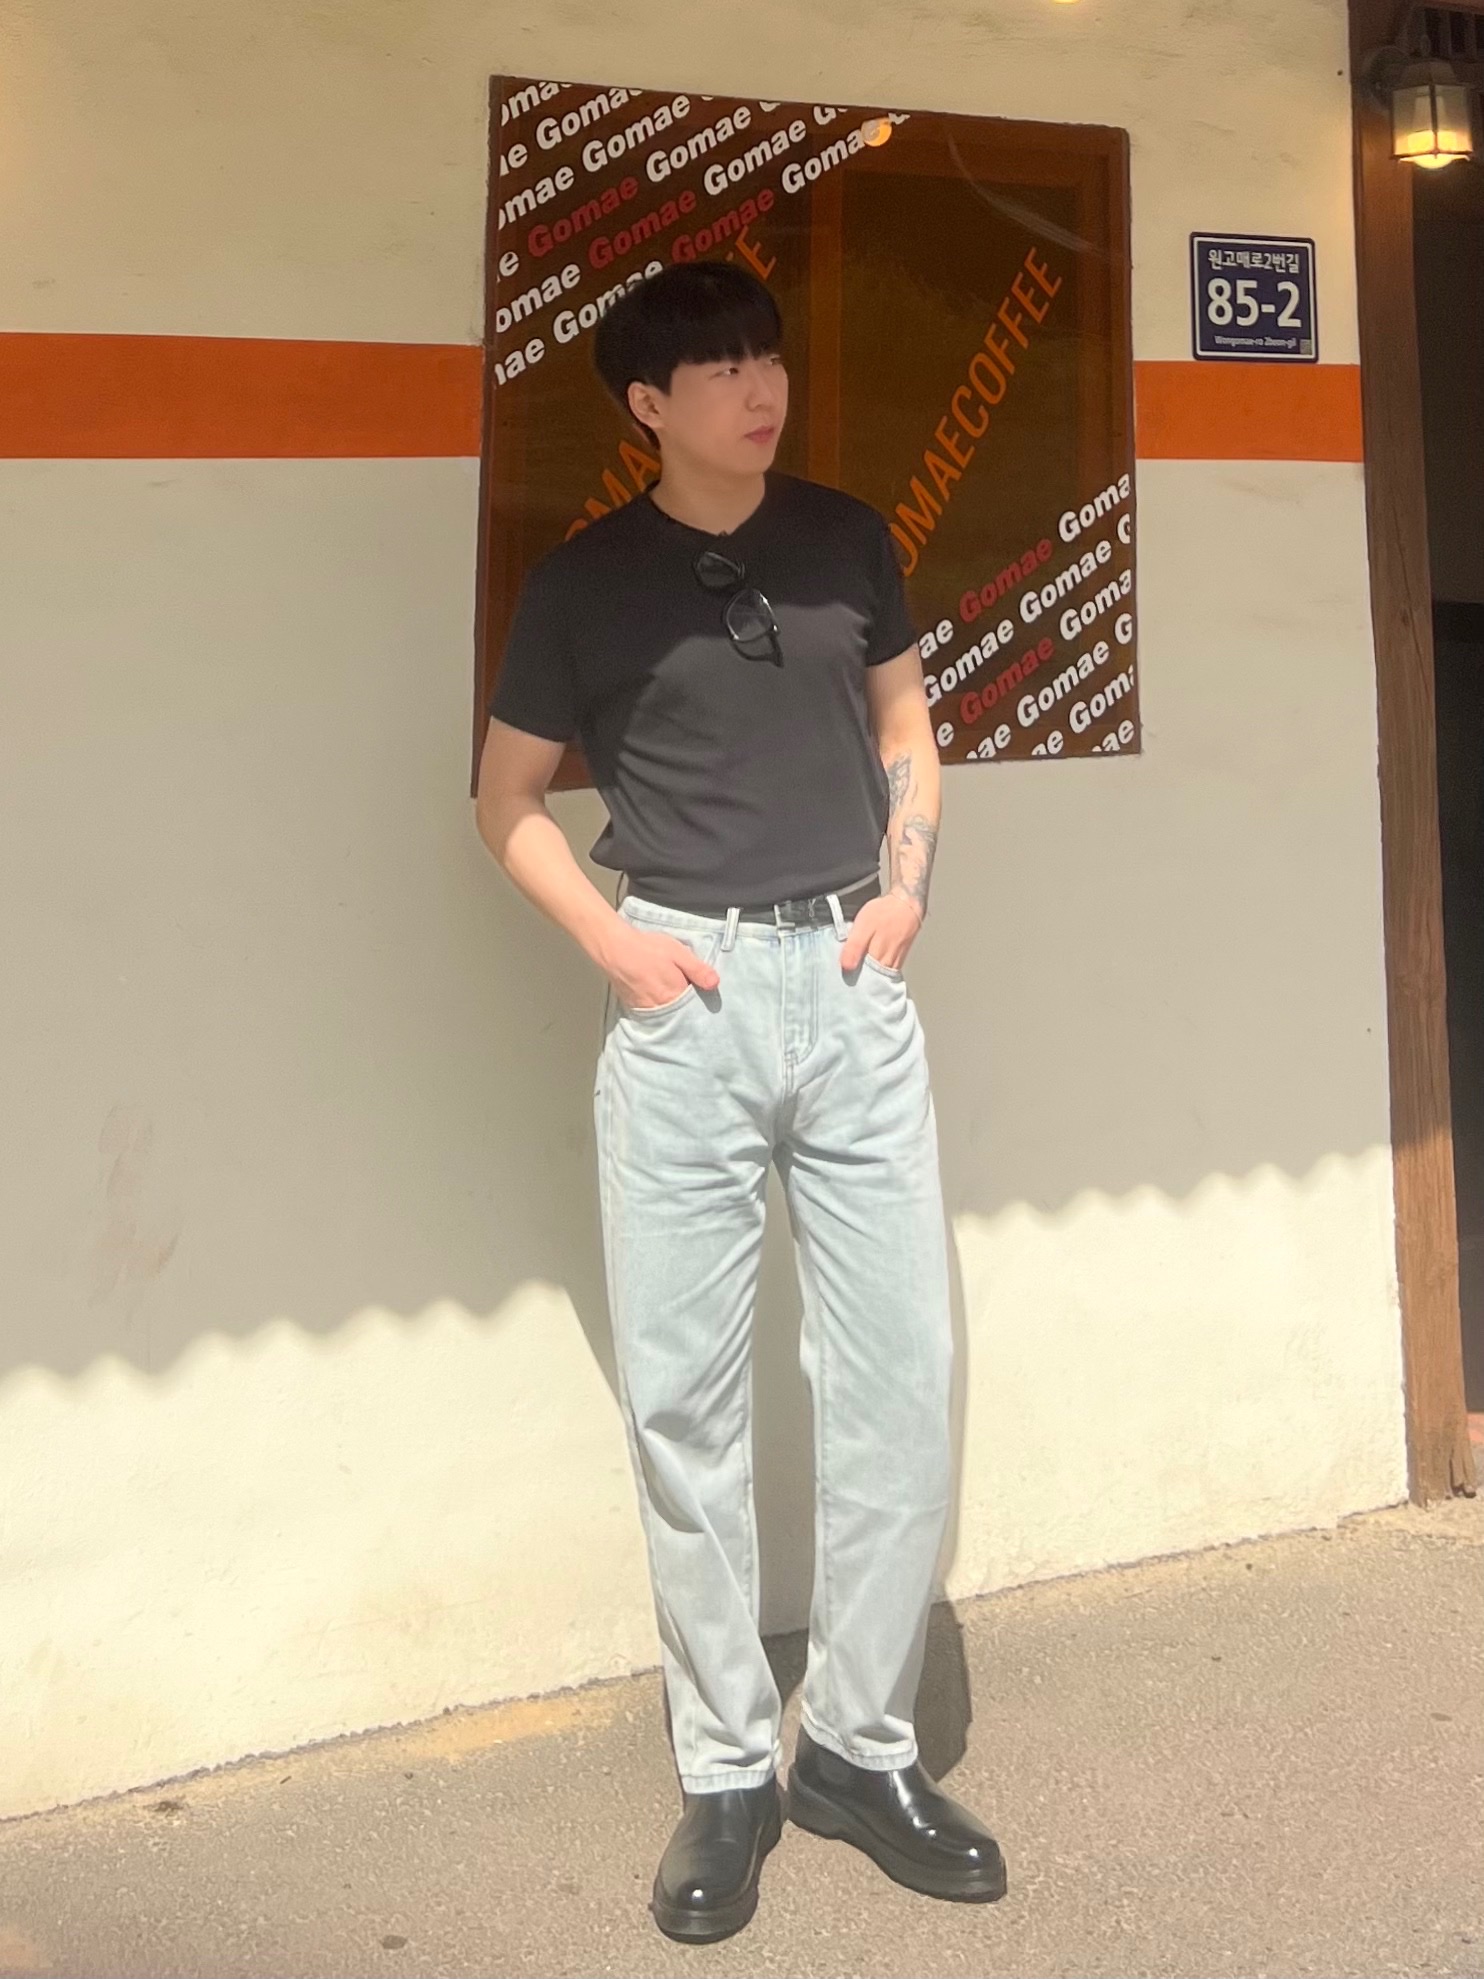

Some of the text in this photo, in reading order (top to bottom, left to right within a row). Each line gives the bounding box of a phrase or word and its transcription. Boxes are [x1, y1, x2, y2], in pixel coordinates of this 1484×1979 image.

[536, 87, 643, 150] Goma
[582, 95, 690, 172] Gomae
[528, 176, 639, 257] Gomae
[646, 106, 752, 183] Gomae
[587, 190, 697, 269] Gomae
[704, 119, 806, 195] Gomae
[671, 188, 775, 263] Gomae
[1207, 249, 1300, 275] 원고매로2번길
[1207, 277, 1302, 327] 85-2
[959, 538, 1053, 623] Gomae
[924, 619, 1015, 708] Gomae
[1019, 540, 1112, 623] Gomae
[959, 637, 1054, 725] Gomae
[1016, 641, 1110, 728] Gomae
